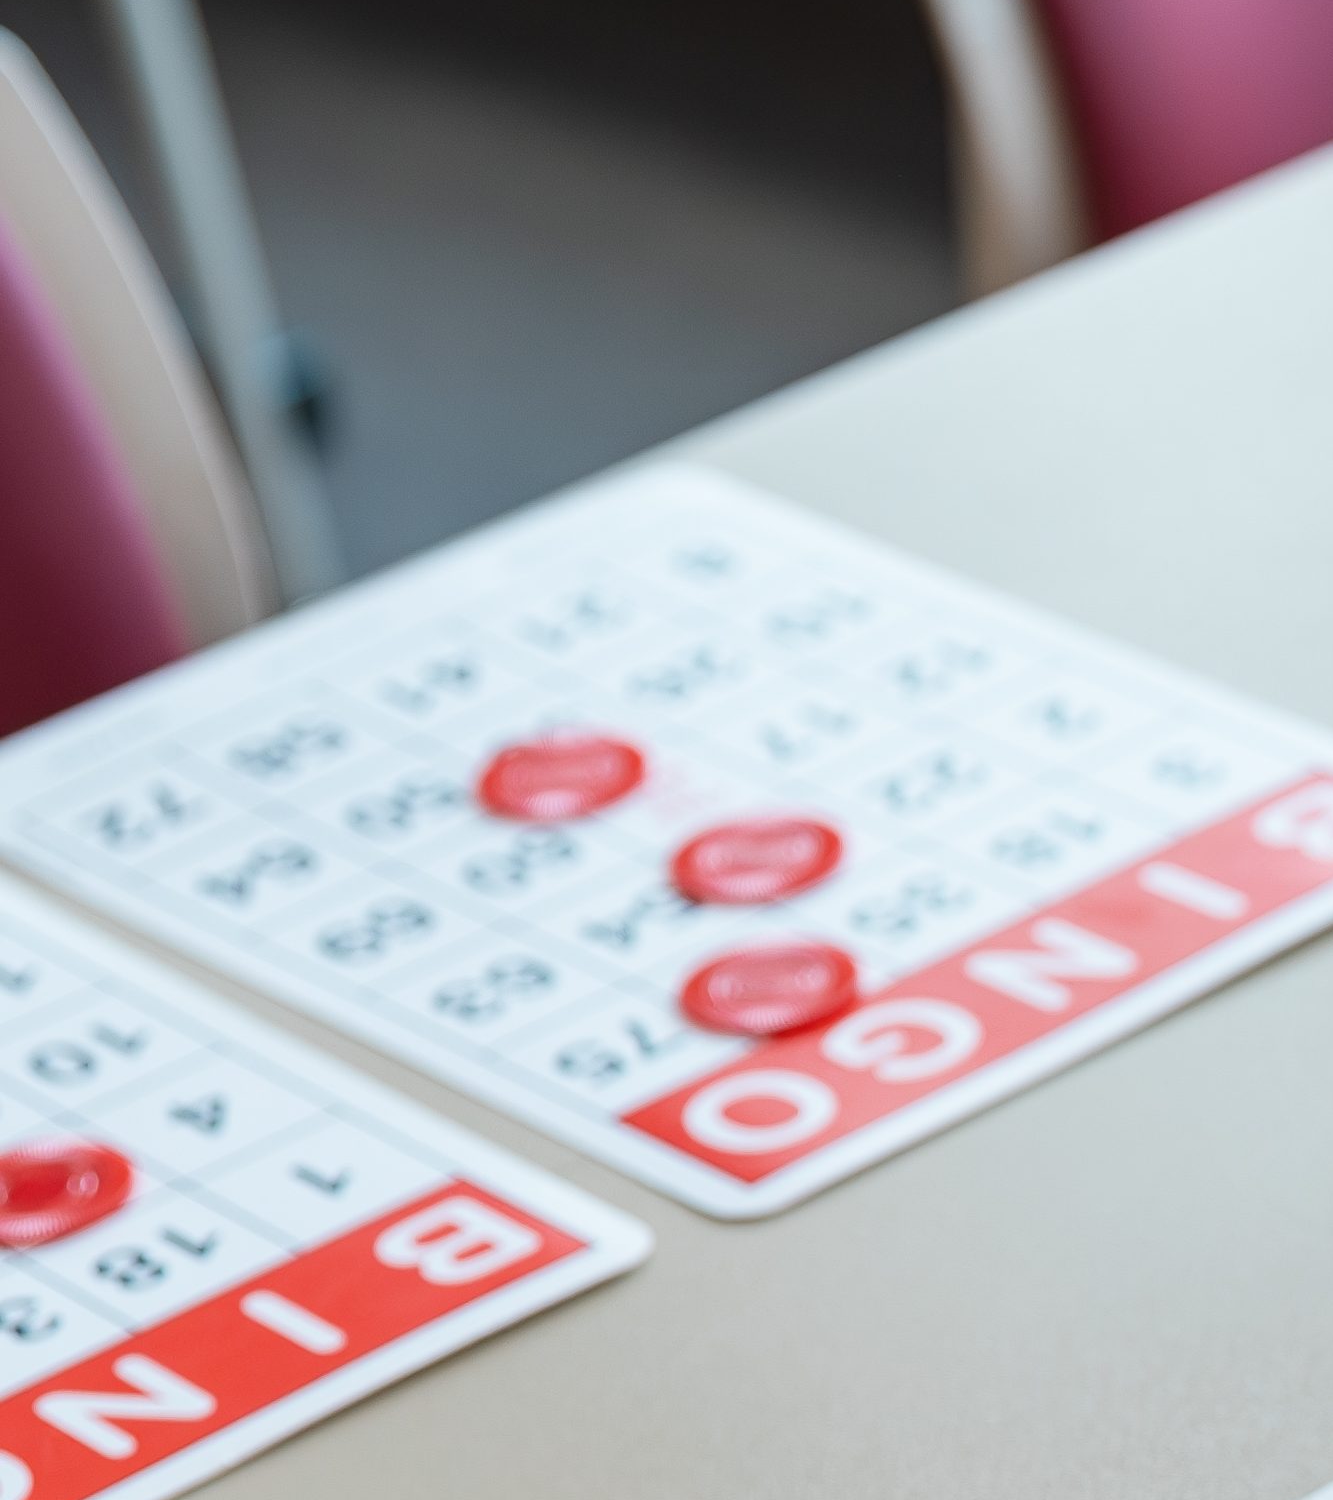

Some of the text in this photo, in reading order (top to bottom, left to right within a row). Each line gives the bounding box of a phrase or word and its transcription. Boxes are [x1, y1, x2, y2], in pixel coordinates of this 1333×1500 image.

[94, 781, 195, 850] 72
[27, 1019, 151, 1088] 10
[553, 1016, 657, 1087] 75
[169, 1094, 229, 1136] 4
[292, 1157, 352, 1200] 1
[91, 1222, 219, 1292] 18
